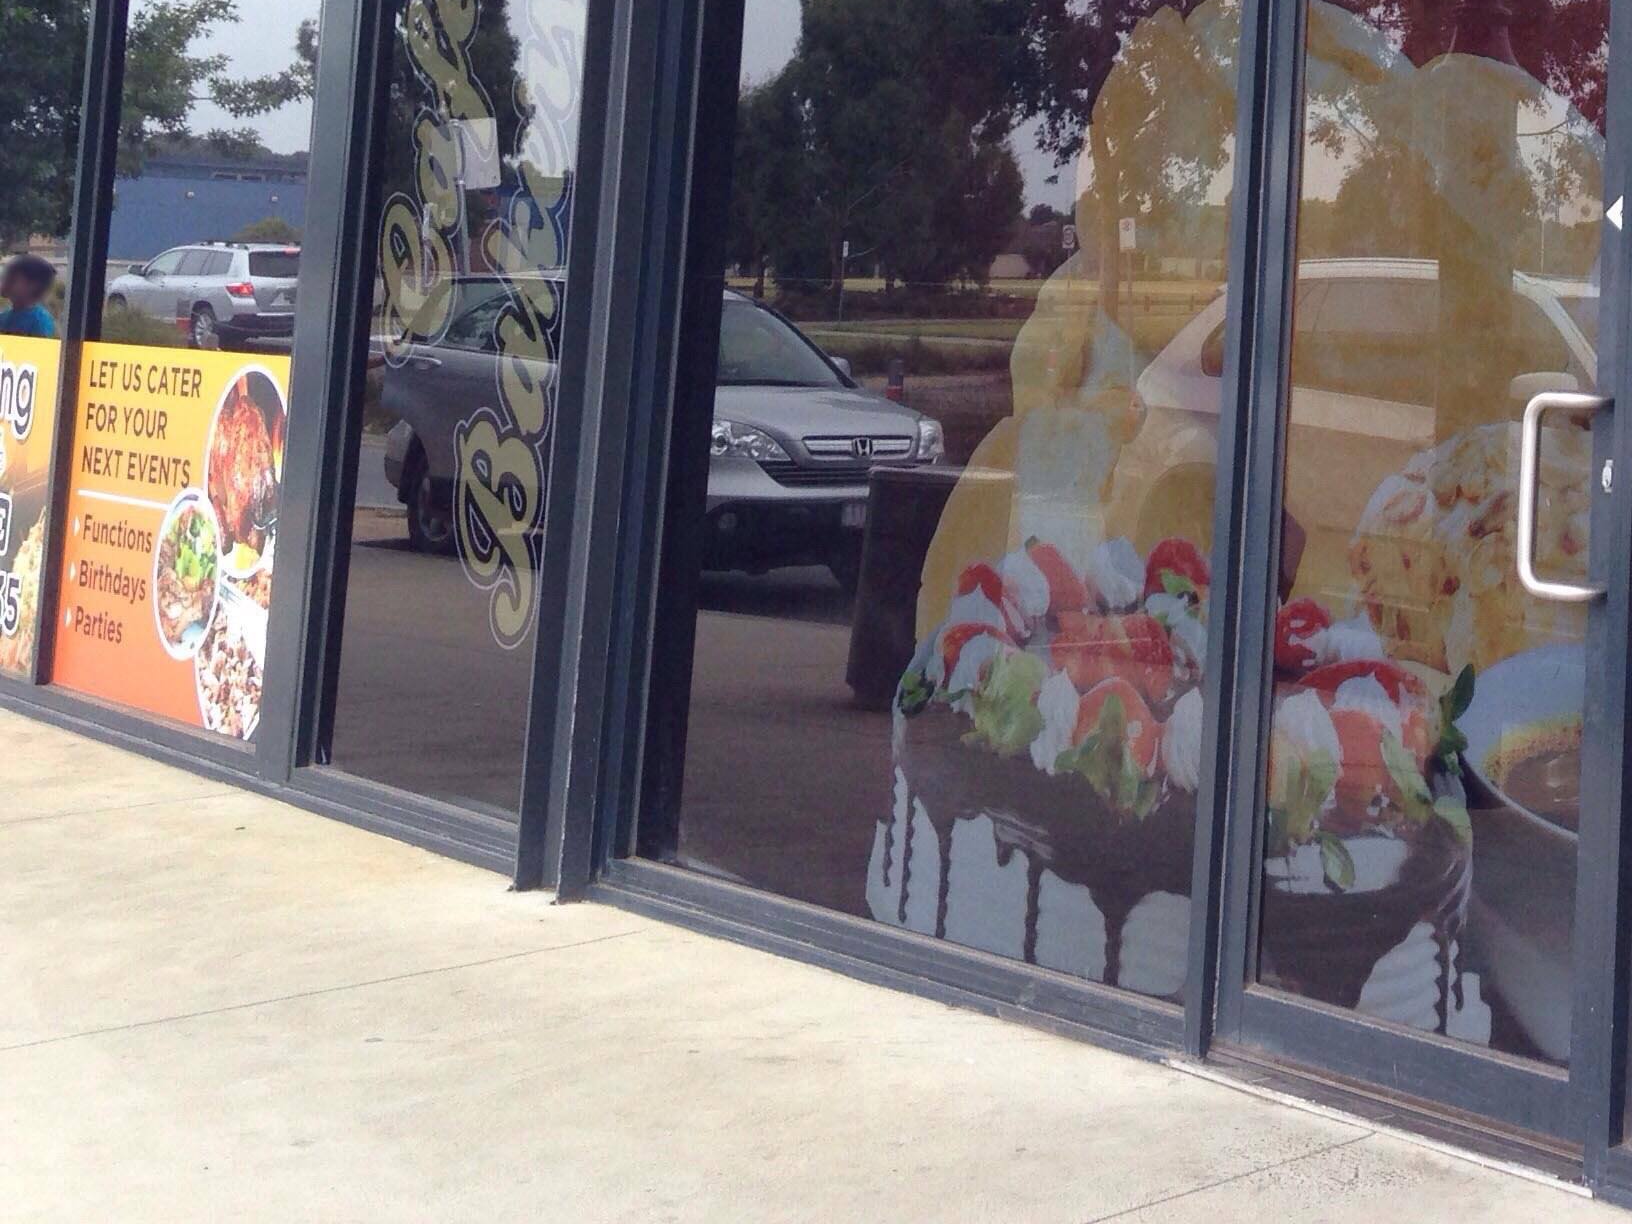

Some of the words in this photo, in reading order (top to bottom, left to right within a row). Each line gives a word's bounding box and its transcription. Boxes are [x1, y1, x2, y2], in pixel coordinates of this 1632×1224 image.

[89, 360, 118, 388] LET
[121, 363, 142, 392] US
[147, 366, 202, 398] CATER
[85, 403, 118, 432] FOR
[123, 408, 168, 440] YOUR
[82, 446, 124, 480] NEXT
[127, 452, 191, 489] EVENTS
[83, 515, 153, 554] Functions
[79, 560, 147, 604] Birthdays
[75, 606, 123, 645] Parties
